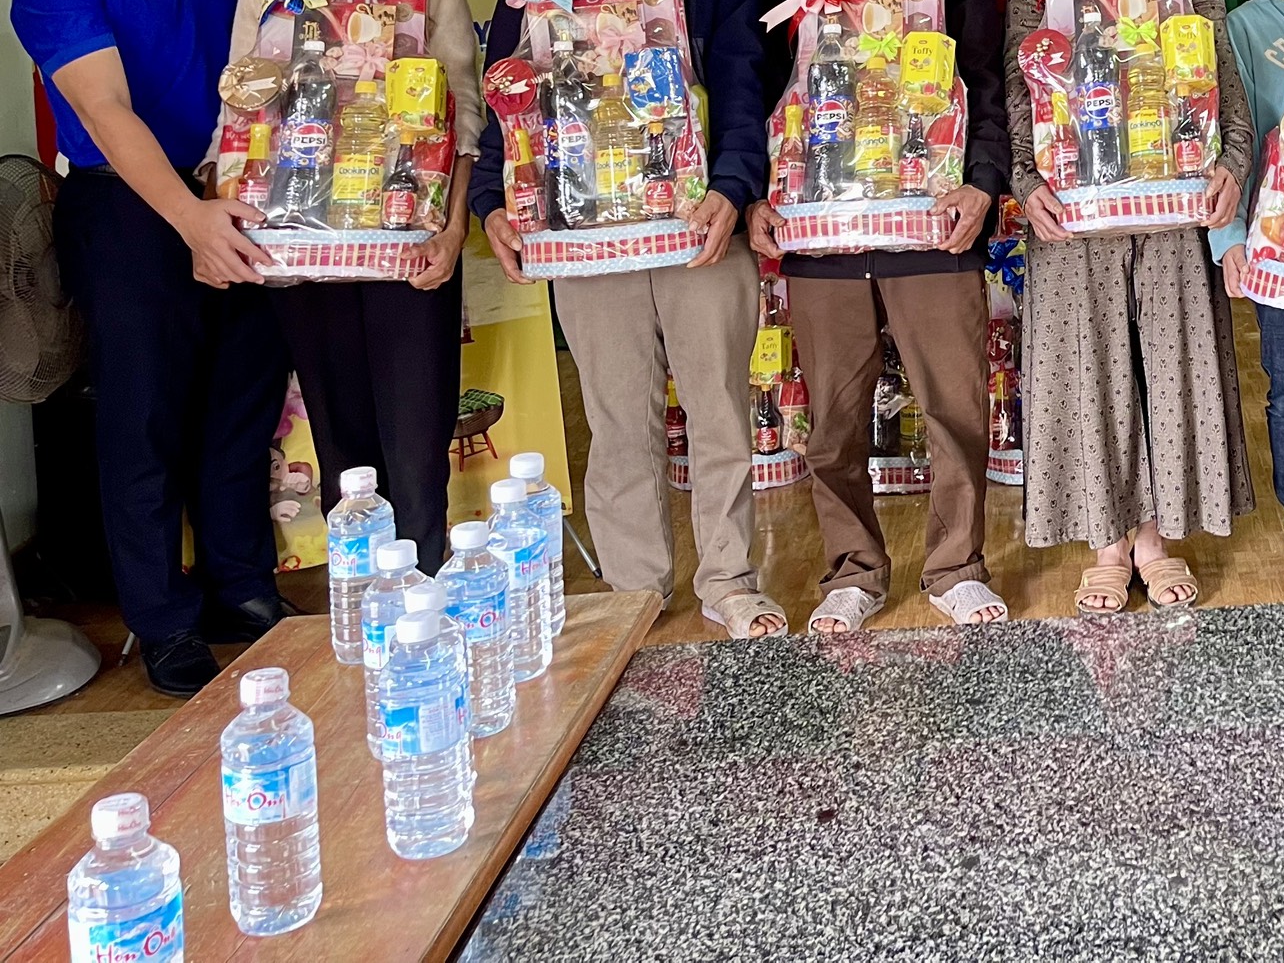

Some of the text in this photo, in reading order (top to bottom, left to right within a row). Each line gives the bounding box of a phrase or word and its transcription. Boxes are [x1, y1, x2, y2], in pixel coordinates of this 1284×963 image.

[1086, 99, 1114, 108] PEPSI
[816, 111, 846, 121] PEPSI
[292, 136, 326, 146] PEPSI
[560, 133, 587, 145] PEPS
